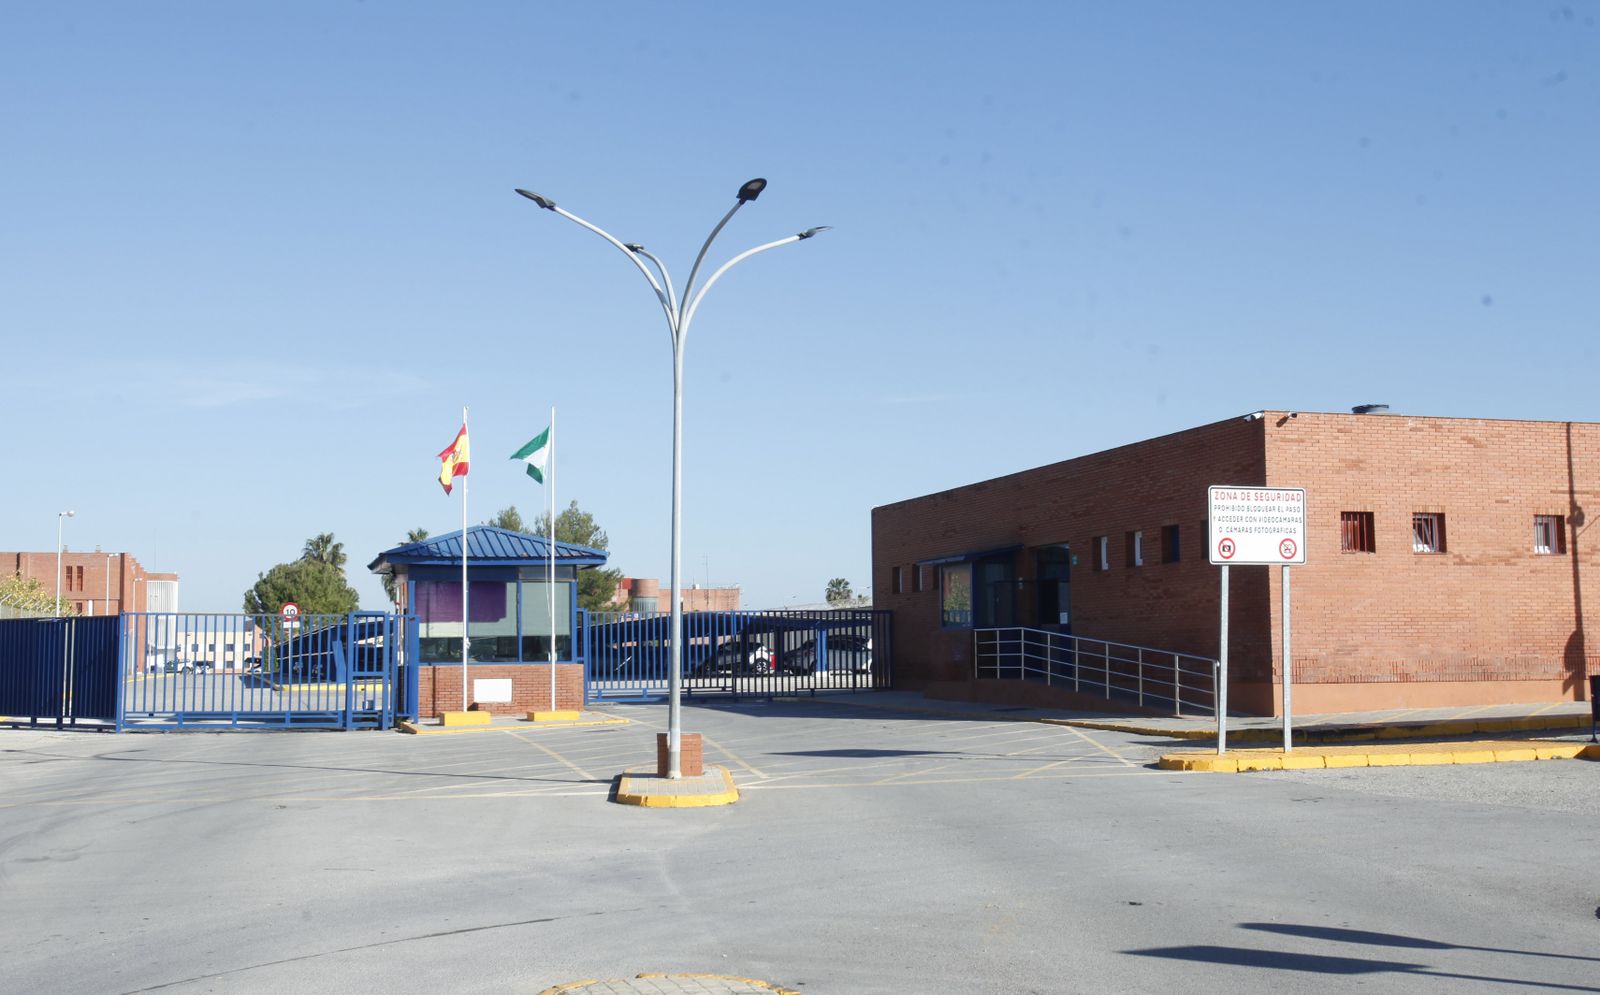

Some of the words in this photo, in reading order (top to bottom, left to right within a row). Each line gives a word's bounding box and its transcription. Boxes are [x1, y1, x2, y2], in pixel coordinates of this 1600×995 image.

[1214, 491, 1237, 500] ZONA
[1241, 492, 1251, 501] DE
[1254, 493, 1302, 502] SEGURIDAD
[1247, 505, 1276, 513] BLOQUEAR
[286, 608, 296, 616] 10
